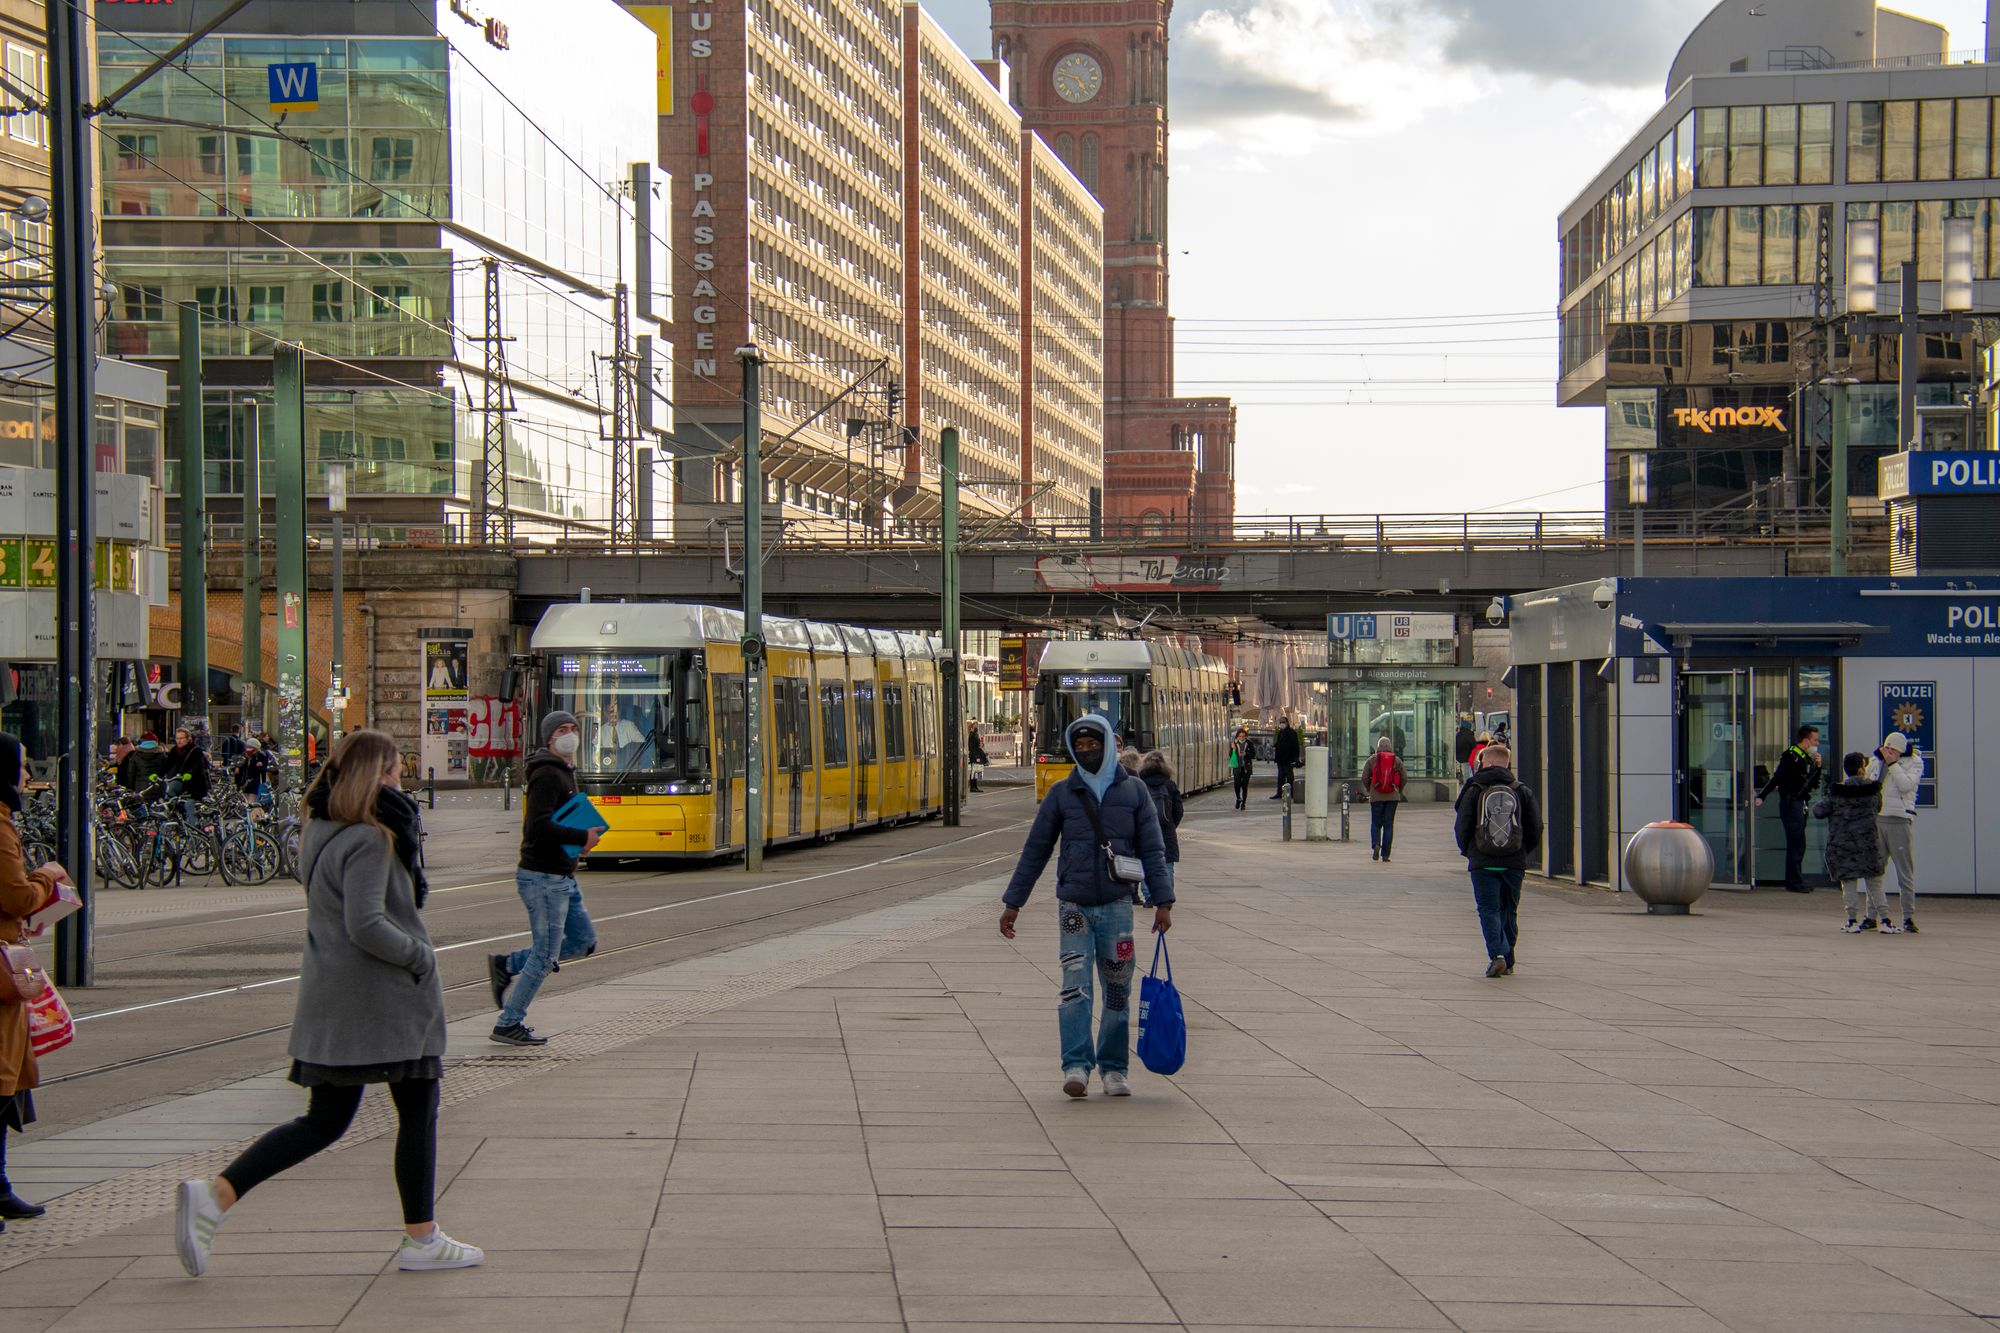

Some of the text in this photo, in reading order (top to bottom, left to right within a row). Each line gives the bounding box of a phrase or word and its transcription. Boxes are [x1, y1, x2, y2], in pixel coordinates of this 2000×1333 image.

[688, 0, 713, 58] US
[275, 67, 308, 98] W
[691, 173, 717, 376] PASSAGEN
[1932, 459, 2000, 486] POLI
[31, 547, 56, 577] 4
[1332, 616, 1350, 638] U
[1395, 617, 1409, 626] U8
[1395, 628, 1409, 637] U5
[1927, 633, 1962, 644] Wache
[1964, 635, 1981, 644] am
[1355, 669, 1428, 681] U Alexanderplatz
[1883, 686, 1933, 698] POLIZEI
